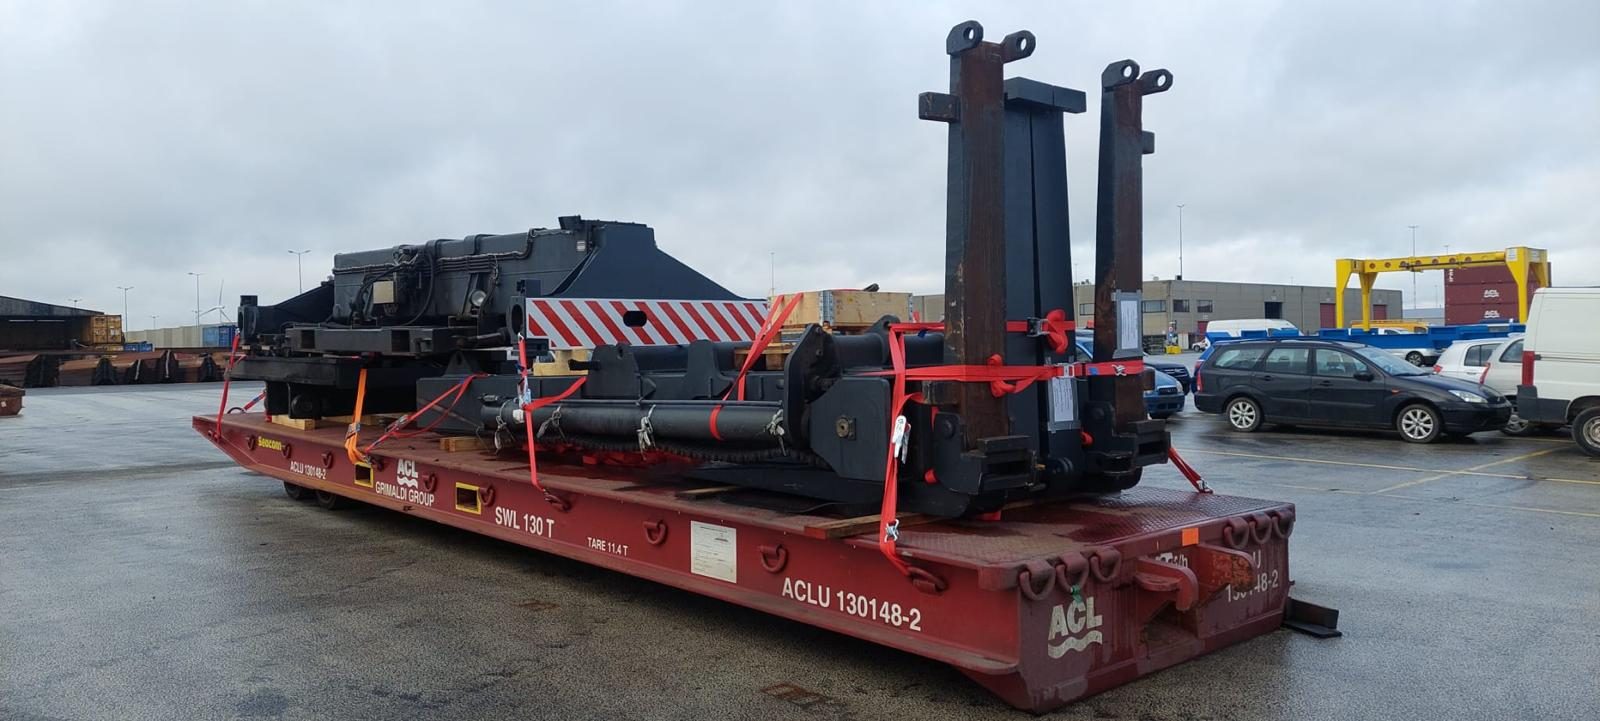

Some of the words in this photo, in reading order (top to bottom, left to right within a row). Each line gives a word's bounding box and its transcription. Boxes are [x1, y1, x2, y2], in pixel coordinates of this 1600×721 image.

[290, 461, 303, 474] ACLU
[305, 464, 326, 479] 130148-2
[397, 458, 418, 478] ACL
[375, 481, 407, 500] GRIMALDI
[409, 489, 434, 506] GROUP
[495, 506, 520, 530] SWL
[523, 513, 544, 535] 130
[546, 518, 555, 538] T
[587, 537, 606, 551] TARE
[607, 543, 622, 555] 11.4
[622, 545, 628, 556] T
[782, 577, 830, 608] ACLU
[836, 590, 921, 632] 130148-2
[1048, 597, 1103, 640] ACL
